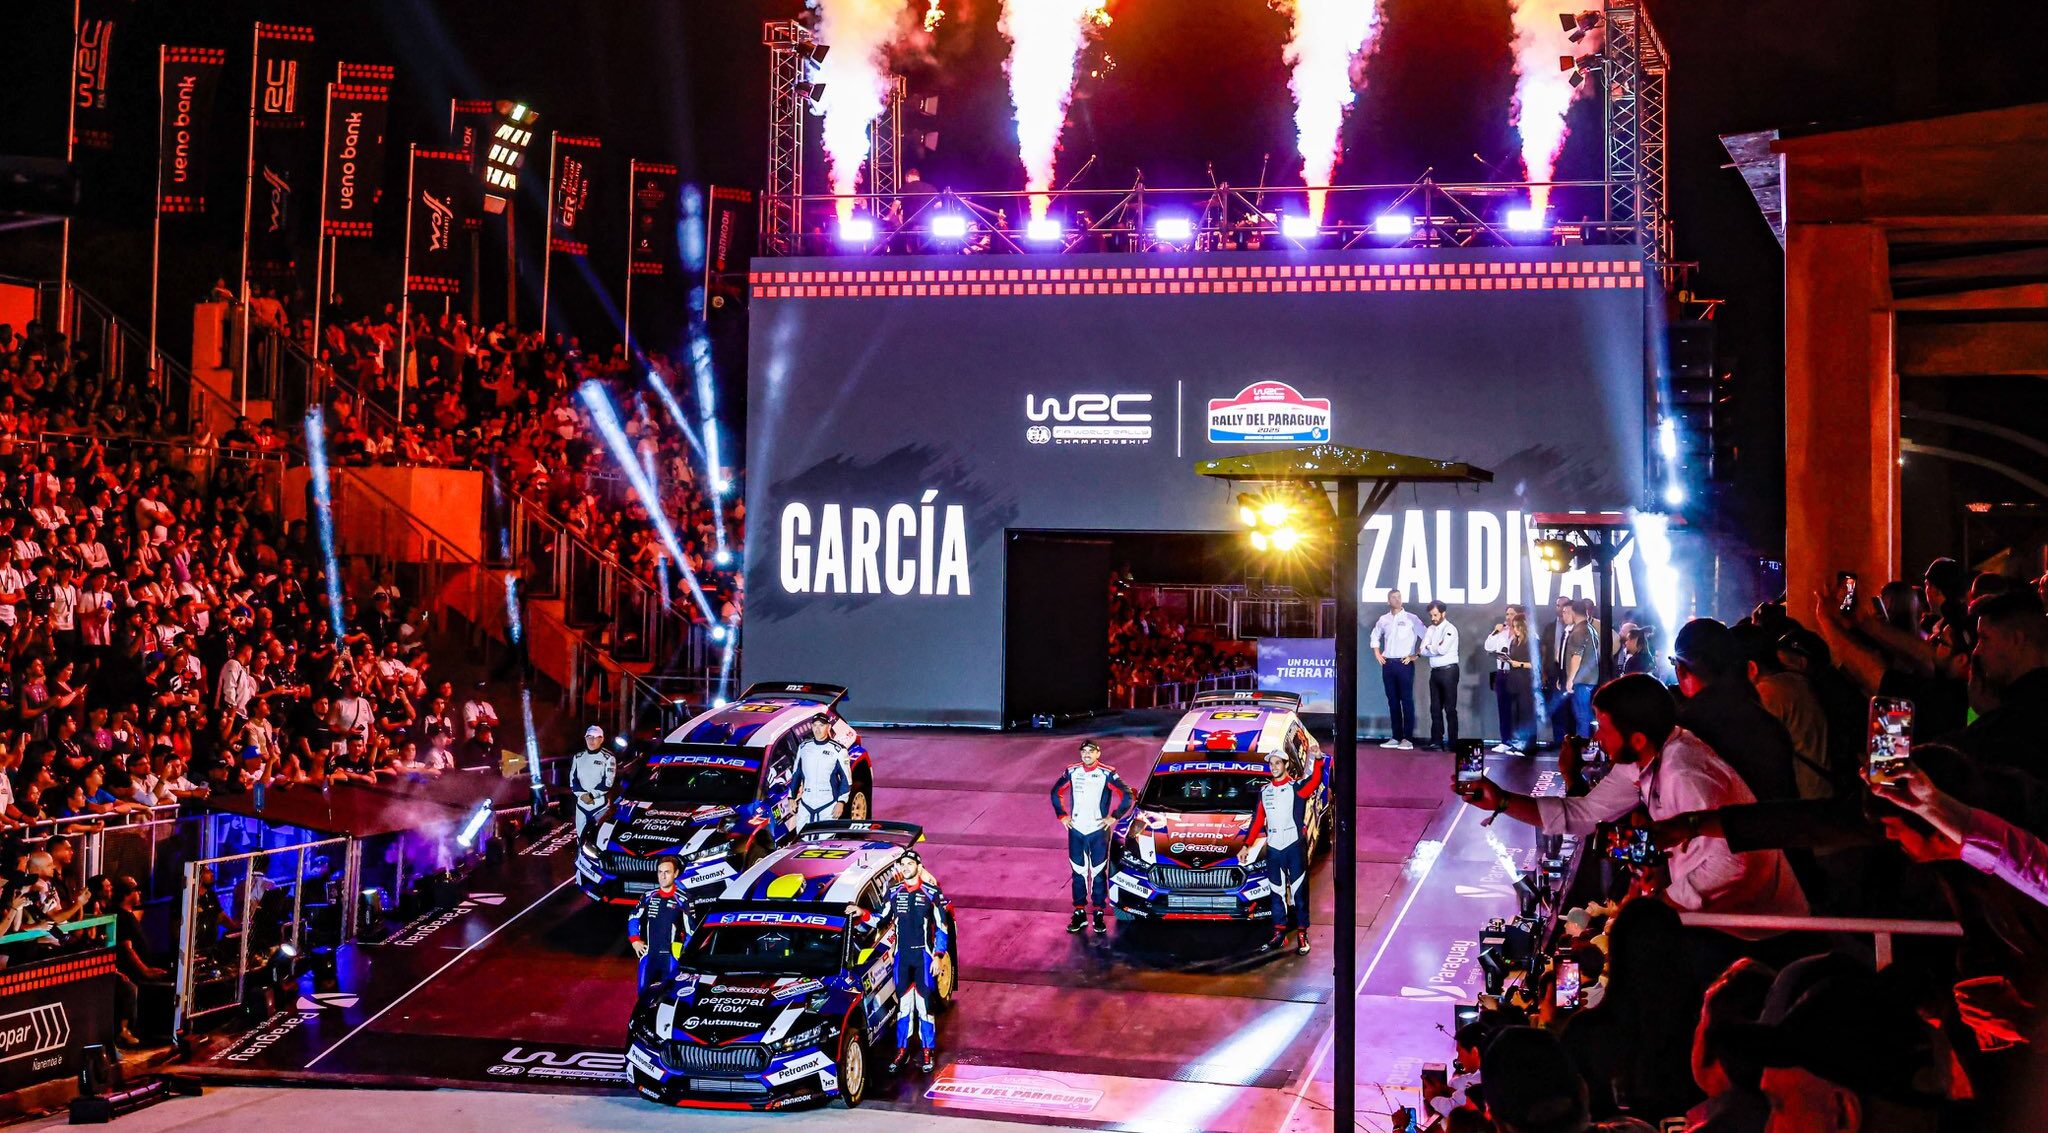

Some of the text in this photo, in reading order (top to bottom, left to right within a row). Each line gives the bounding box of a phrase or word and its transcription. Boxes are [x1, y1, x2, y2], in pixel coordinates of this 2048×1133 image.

[174, 76, 196, 182] ueno bank
[340, 112, 363, 210] ueno bank
[562, 195, 577, 229] GR
[1027, 394, 1152, 421] WRC
[1212, 413, 1326, 426] RALLY DEL PARAGUAY
[780, 489, 971, 596] GARCÍA
[1287, 659, 1301, 667] UN
[1303, 659, 1331, 667] RALLY
[1277, 667, 1322, 678] TIERRA
[673, 756, 745, 767] FORUM8
[1184, 763, 1264, 772] FORUM8
[1530, 771, 1561, 797] araguay
[632, 818, 686, 828] personal
[632, 833, 680, 843] Automotor
[1171, 831, 1234, 839] Petromax
[1185, 844, 1228, 853] Castrol
[690, 868, 725, 884] Petromax
[1250, 887, 1261, 896] TOP
[736, 913, 827, 925] FORUM8
[394, 907, 472, 946] Paraguay
[1429, 940, 1477, 984] Paraguay
[698, 997, 765, 1007] personal
[713, 1004, 746, 1014] flow
[700, 1018, 761, 1028] Automotor
[0, 1025, 31, 1052] opar
[227, 1012, 320, 1061] Paraguay
[502, 1047, 626, 1069] WR
[632, 1050, 655, 1073] Petromax
[493, 1066, 519, 1074] FIA
[560, 1069, 616, 1077] WORLD
[779, 1058, 819, 1079] Petromax
[527, 1074, 627, 1083] CHAMPION
[935, 1085, 980, 1094] RALLY
[981, 1088, 1009, 1097] DEL
[1011, 1090, 1093, 1104] PARAGUAY
